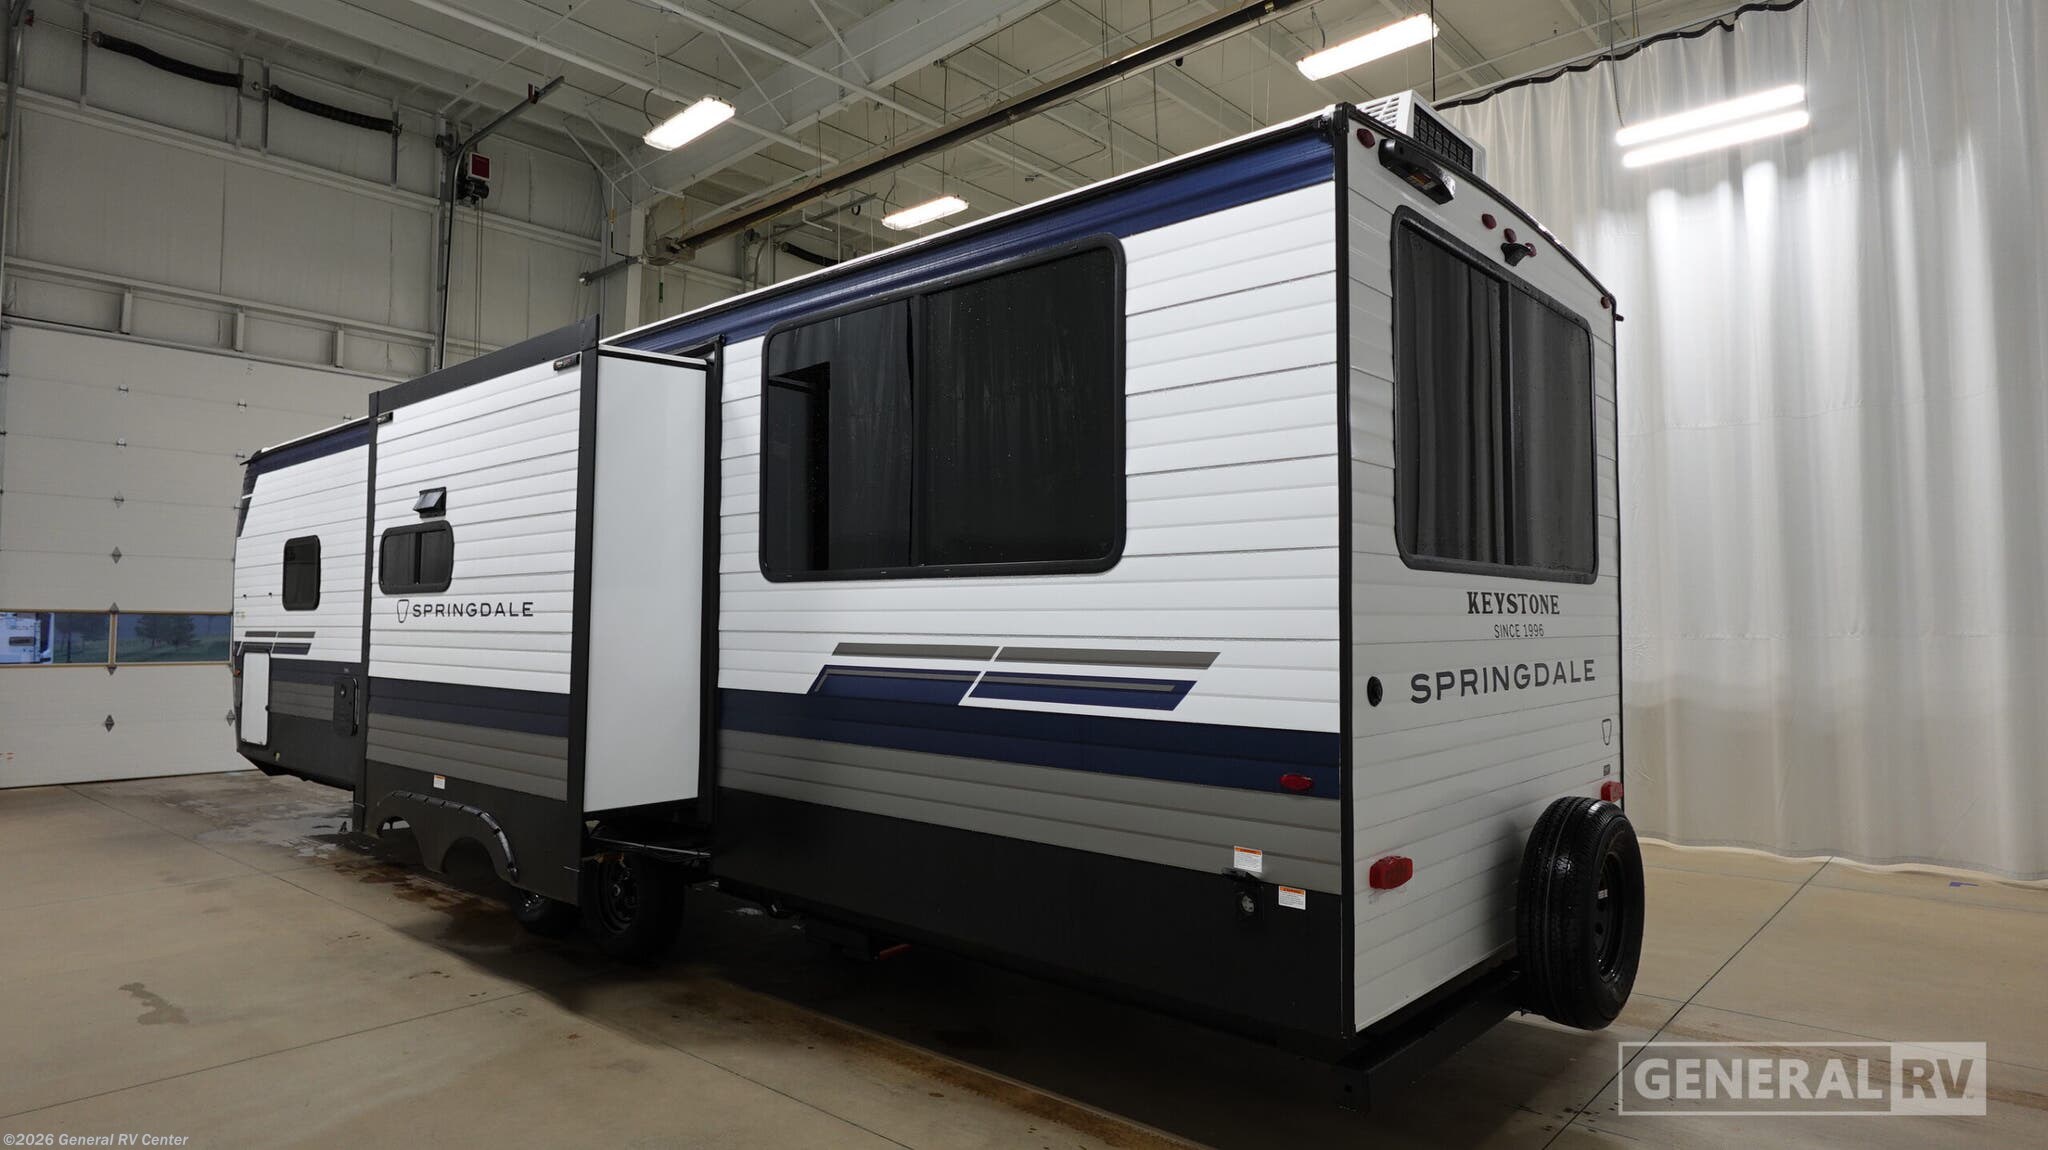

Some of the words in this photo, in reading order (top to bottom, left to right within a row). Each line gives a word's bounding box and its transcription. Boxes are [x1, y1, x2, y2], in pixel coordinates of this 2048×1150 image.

[412, 602, 533, 617] SPRINGDALE
[1466, 591, 1560, 615] KEYSTONE
[1494, 624, 1521, 639] SINCE
[1523, 624, 1544, 638] 1996
[1410, 659, 1596, 705] SPRINGDALE
